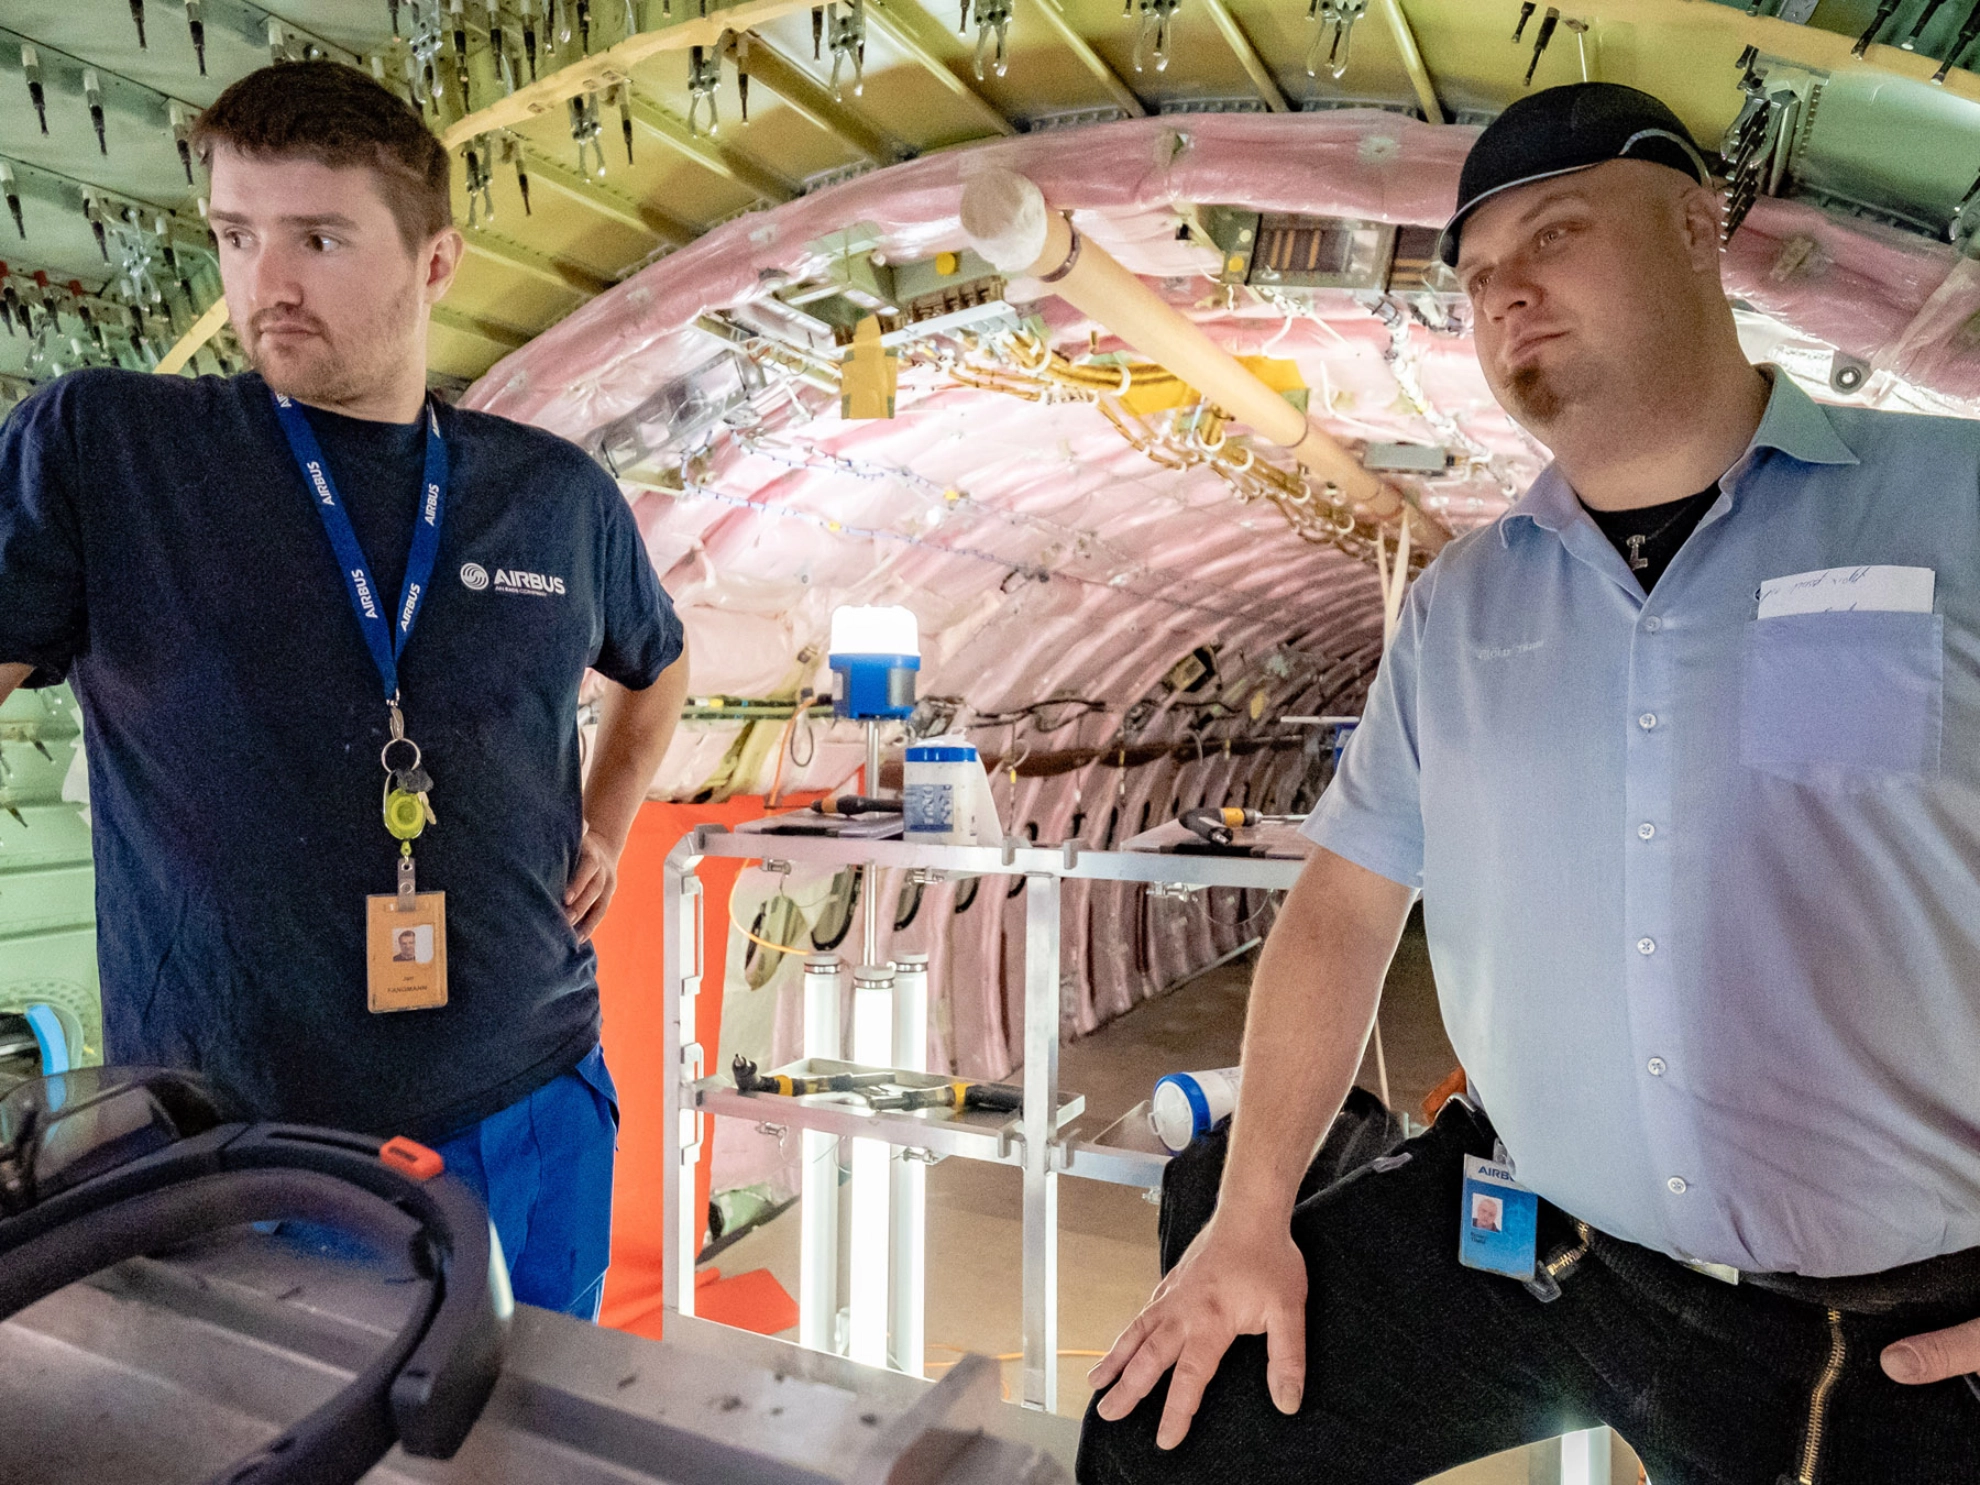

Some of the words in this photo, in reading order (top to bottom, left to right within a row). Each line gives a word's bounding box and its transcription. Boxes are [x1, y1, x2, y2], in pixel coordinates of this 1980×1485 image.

[306, 461, 335, 506] AIRBUS
[424, 483, 440, 527] AIRBUS
[350, 569, 378, 619] AIRBUS
[494, 568, 566, 594] AIRBUS
[400, 583, 421, 632] AIRBUS
